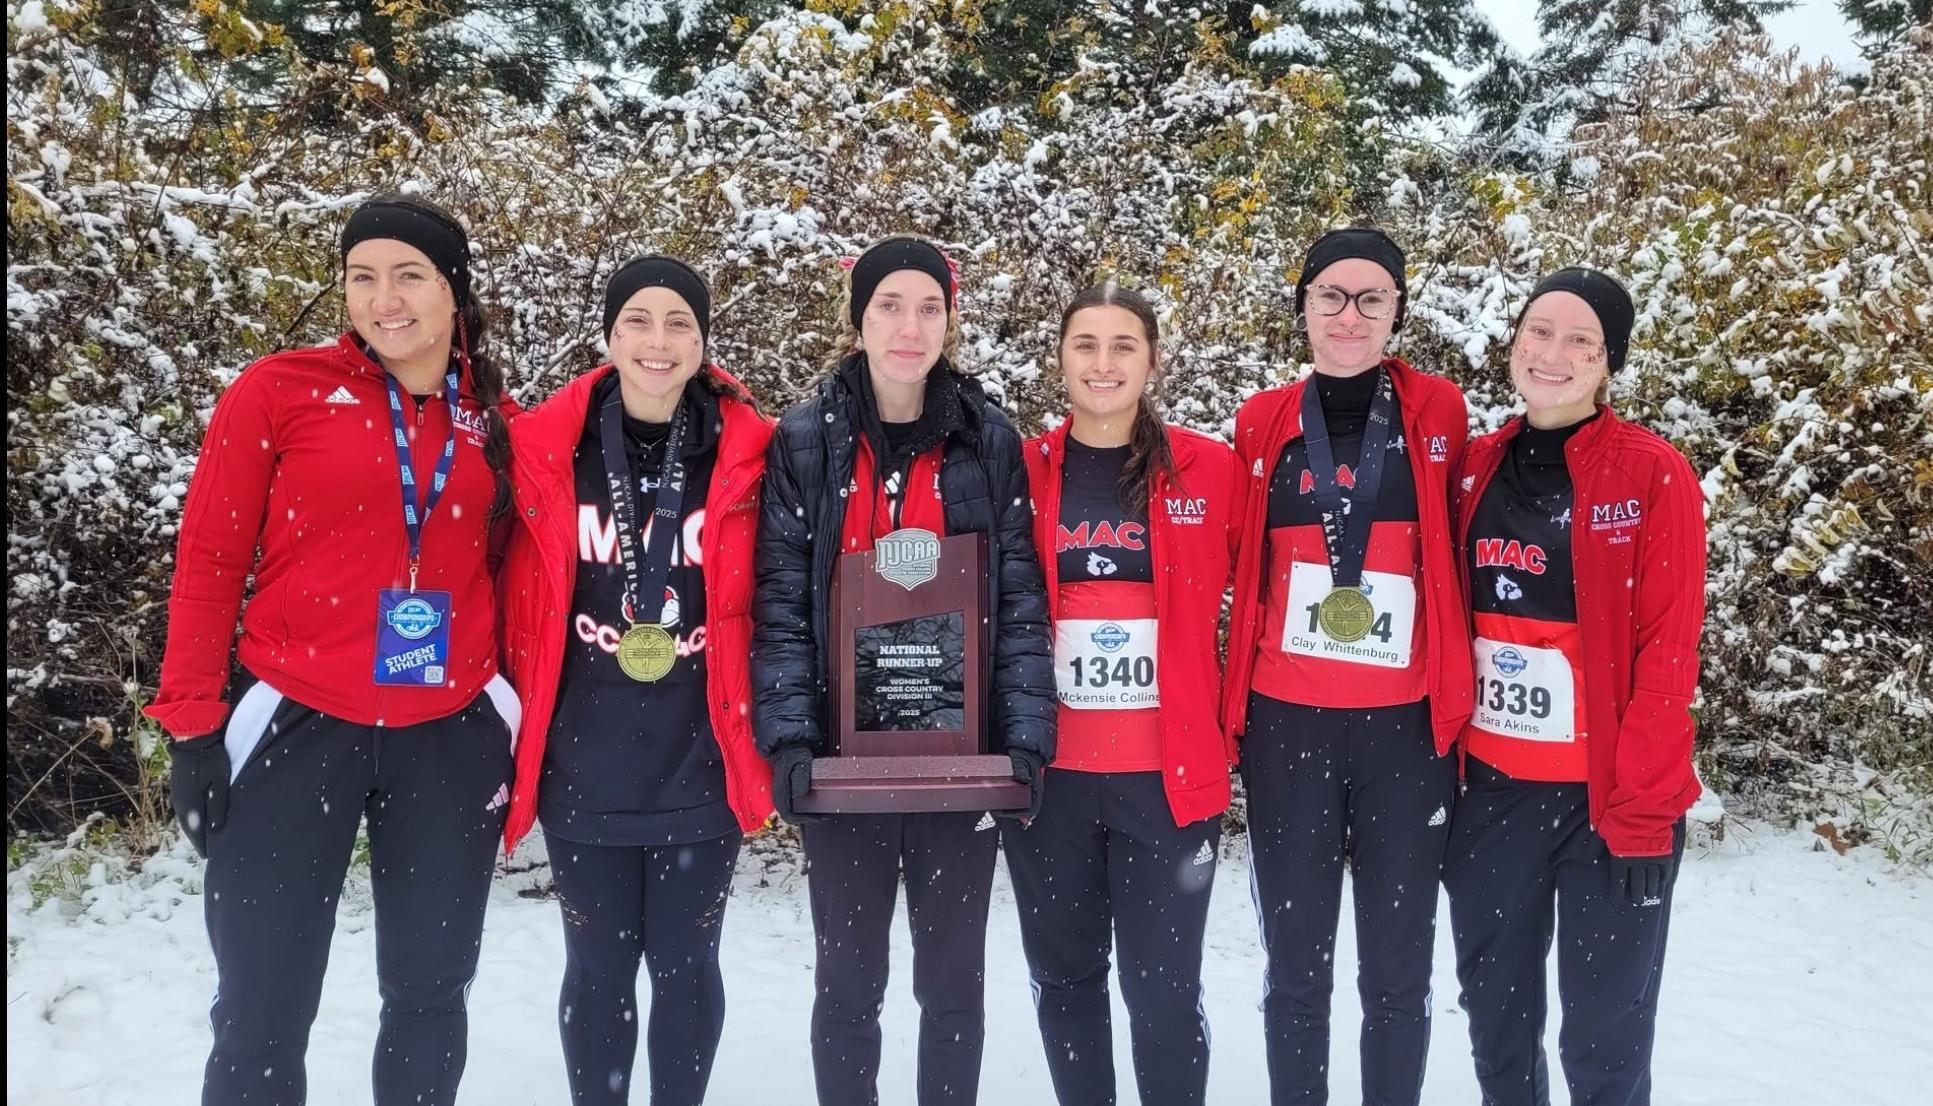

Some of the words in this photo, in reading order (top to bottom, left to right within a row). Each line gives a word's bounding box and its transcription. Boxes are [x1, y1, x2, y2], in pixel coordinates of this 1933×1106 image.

[1369, 412, 1389, 425] 2025
[655, 508, 678, 519] 2025
[1165, 498, 1206, 515] MAC
[1592, 499, 1641, 523] MAC
[1057, 521, 1145, 552] MAC
[1591, 522, 1612, 530] CROSS
[1608, 535, 1631, 545] TRACK
[879, 541, 937, 569] NJCAA
[1476, 538, 1547, 575] MAC
[1306, 602, 1392, 643] 14
[385, 644, 436, 667] STUDENT
[880, 645, 940, 655] NATIONAL
[1291, 636, 1317, 651] Clay
[1323, 640, 1399, 663] Whittenburg
[389, 652, 437, 675] ATHLETE
[876, 658, 943, 667] RUNNER-UP
[1069, 656, 1154, 688] 1340
[904, 685, 944, 693] COUNTRY
[1058, 692, 1116, 703] Mckensie
[1478, 675, 1551, 719] 1339
[1480, 712, 1501, 728] Sara
[1504, 719, 1540, 734] Akins
